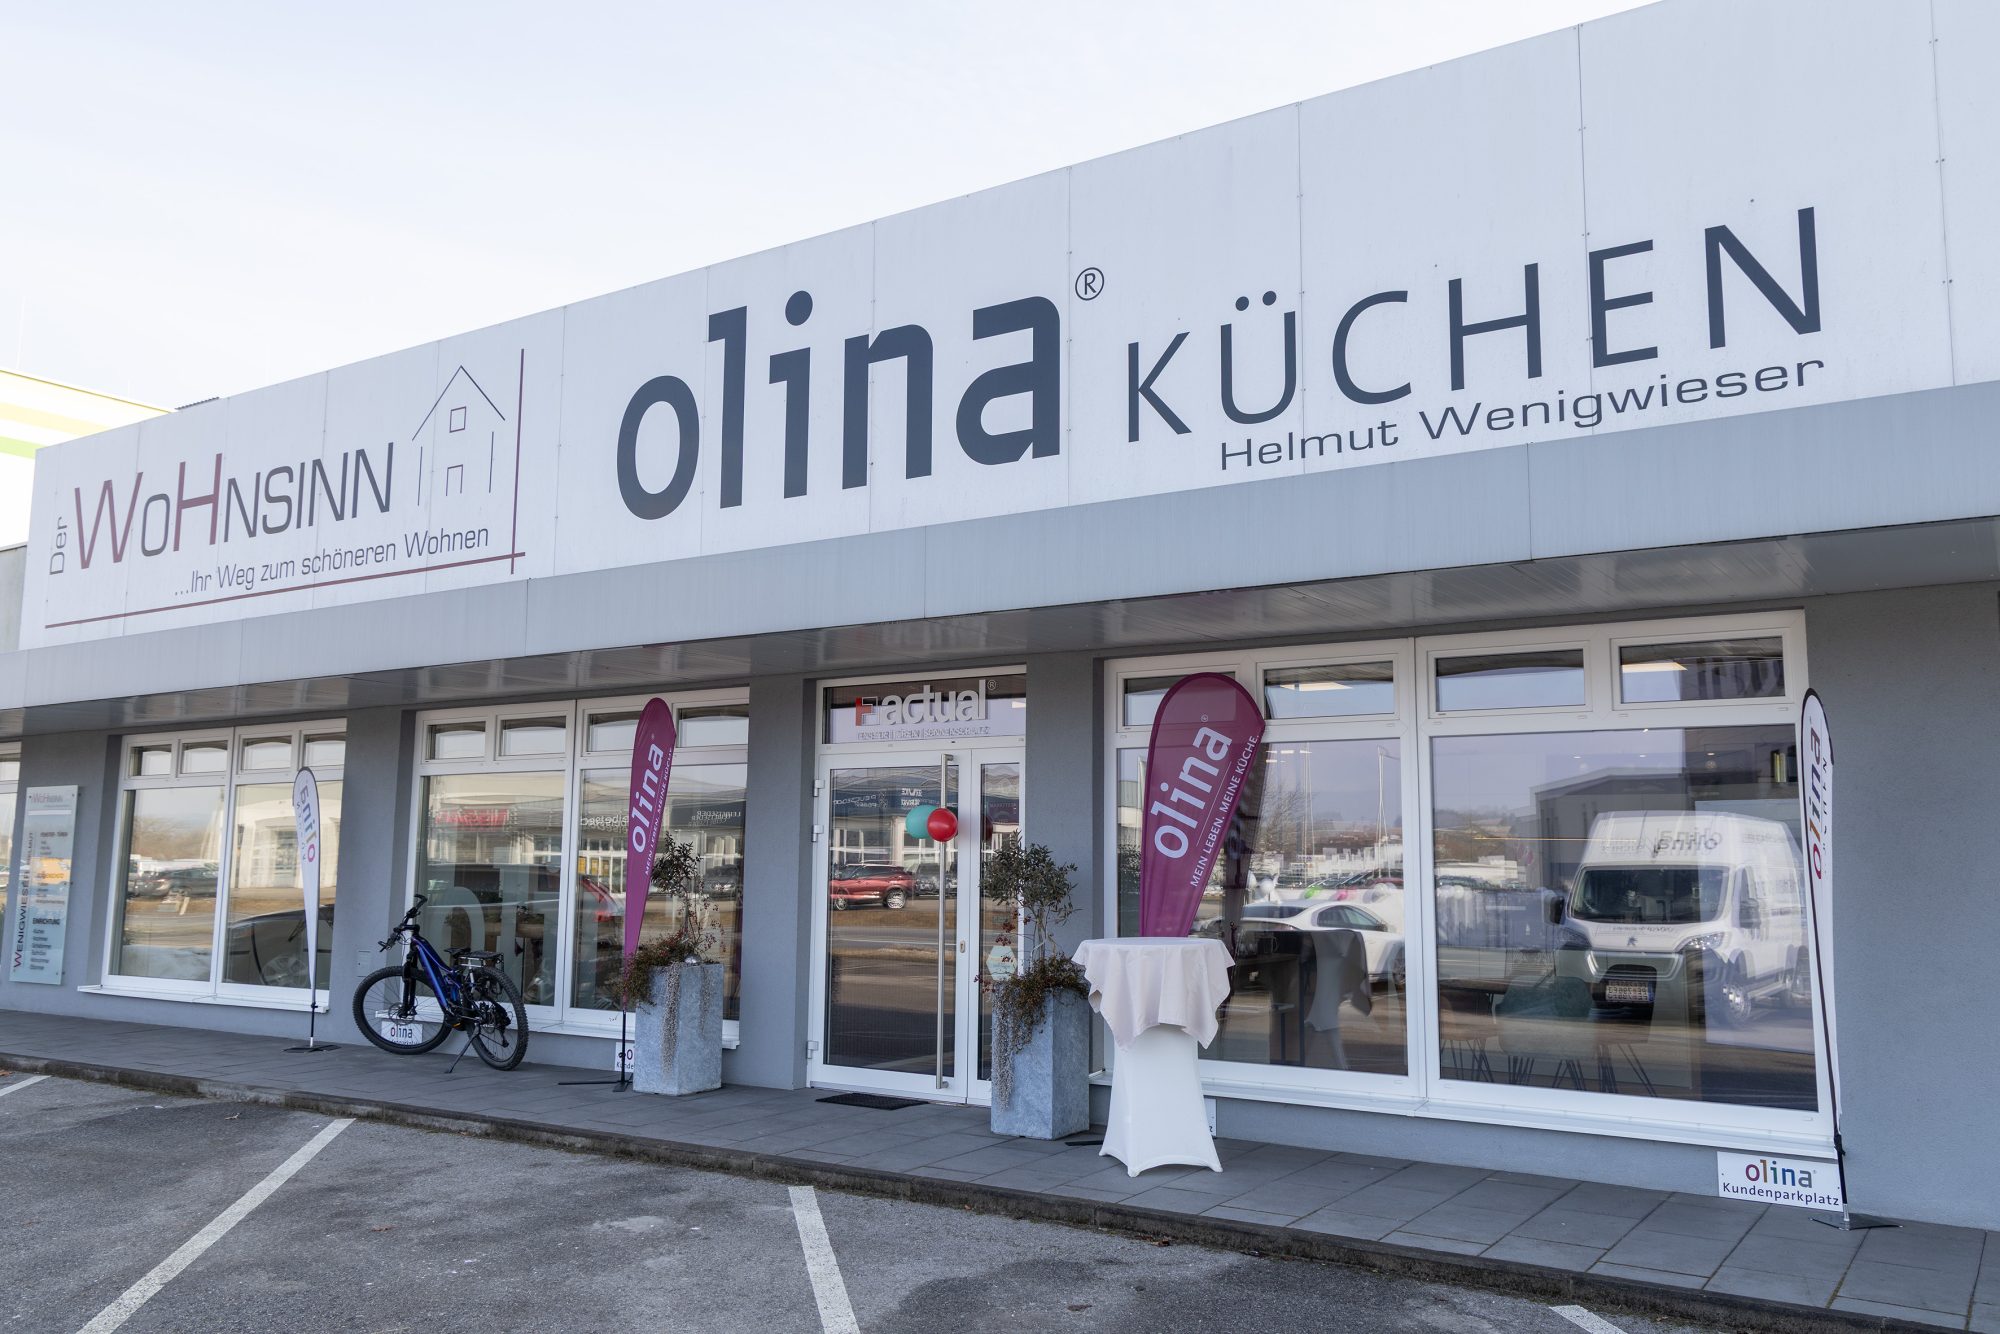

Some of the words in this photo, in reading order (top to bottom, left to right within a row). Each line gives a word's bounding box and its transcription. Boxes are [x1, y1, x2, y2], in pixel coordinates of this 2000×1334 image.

[1127, 206, 1822, 443] KÜCHEN
[616, 290, 1061, 521] olina
[1219, 421, 1400, 470] Helmut
[1418, 357, 1825, 439] Wenigwieser
[49, 516, 67, 576] Der
[217, 563, 255, 591] Weg
[260, 559, 295, 582] zum
[301, 543, 396, 576] schöneren
[404, 527, 489, 559] Wohnen
[632, 743, 664, 853] olina
[1151, 726, 1232, 859] olina
[1190, 857, 1208, 887] MEIN
[1203, 815, 1225, 854] LEBEN.
[1219, 776, 1241, 813] MEINE
[1235, 734, 1260, 775] KÜCHE.
[1722, 1182, 1840, 1206] Kundenparkplatz
[1745, 1159, 1813, 1189] olina
